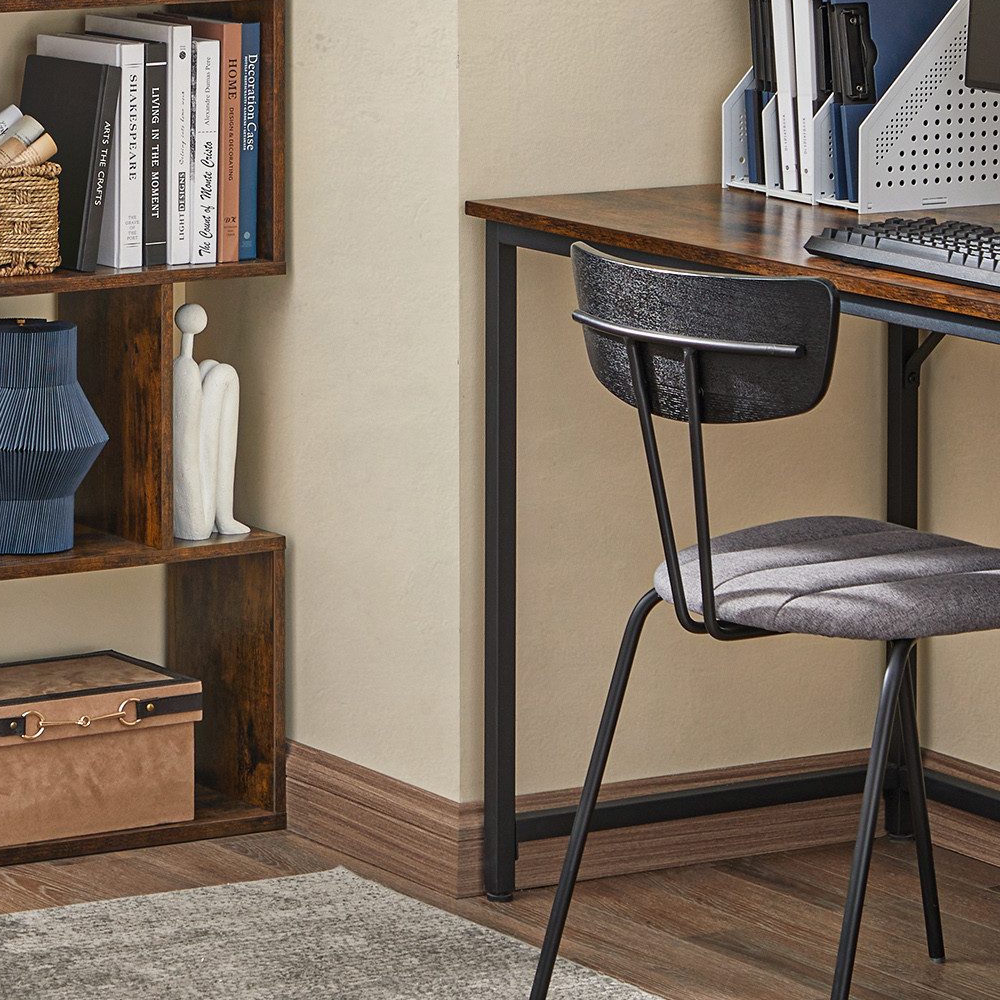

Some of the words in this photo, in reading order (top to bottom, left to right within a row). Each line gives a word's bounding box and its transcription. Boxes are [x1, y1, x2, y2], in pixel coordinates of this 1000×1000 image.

[228, 59, 237, 100] HOME
[247, 54, 258, 120] Decoration
[151, 87, 161, 124] LIVING
[102, 121, 111, 145] ARTS
[129, 74, 138, 181] SHAKESPEARE
[151, 129, 159, 140] IN
[247, 122, 257, 151] Case
[100, 148, 108, 167] THE
[151, 144, 159, 167] THE
[200, 141, 215, 168] Cristo
[94, 171, 105, 206] CRAFTS
[151, 171, 159, 218] MOMENT
[200, 171, 212, 200] Monte
[201, 205, 215, 213] of
[199, 215, 213, 239] Count
[198, 241, 211, 257] The
